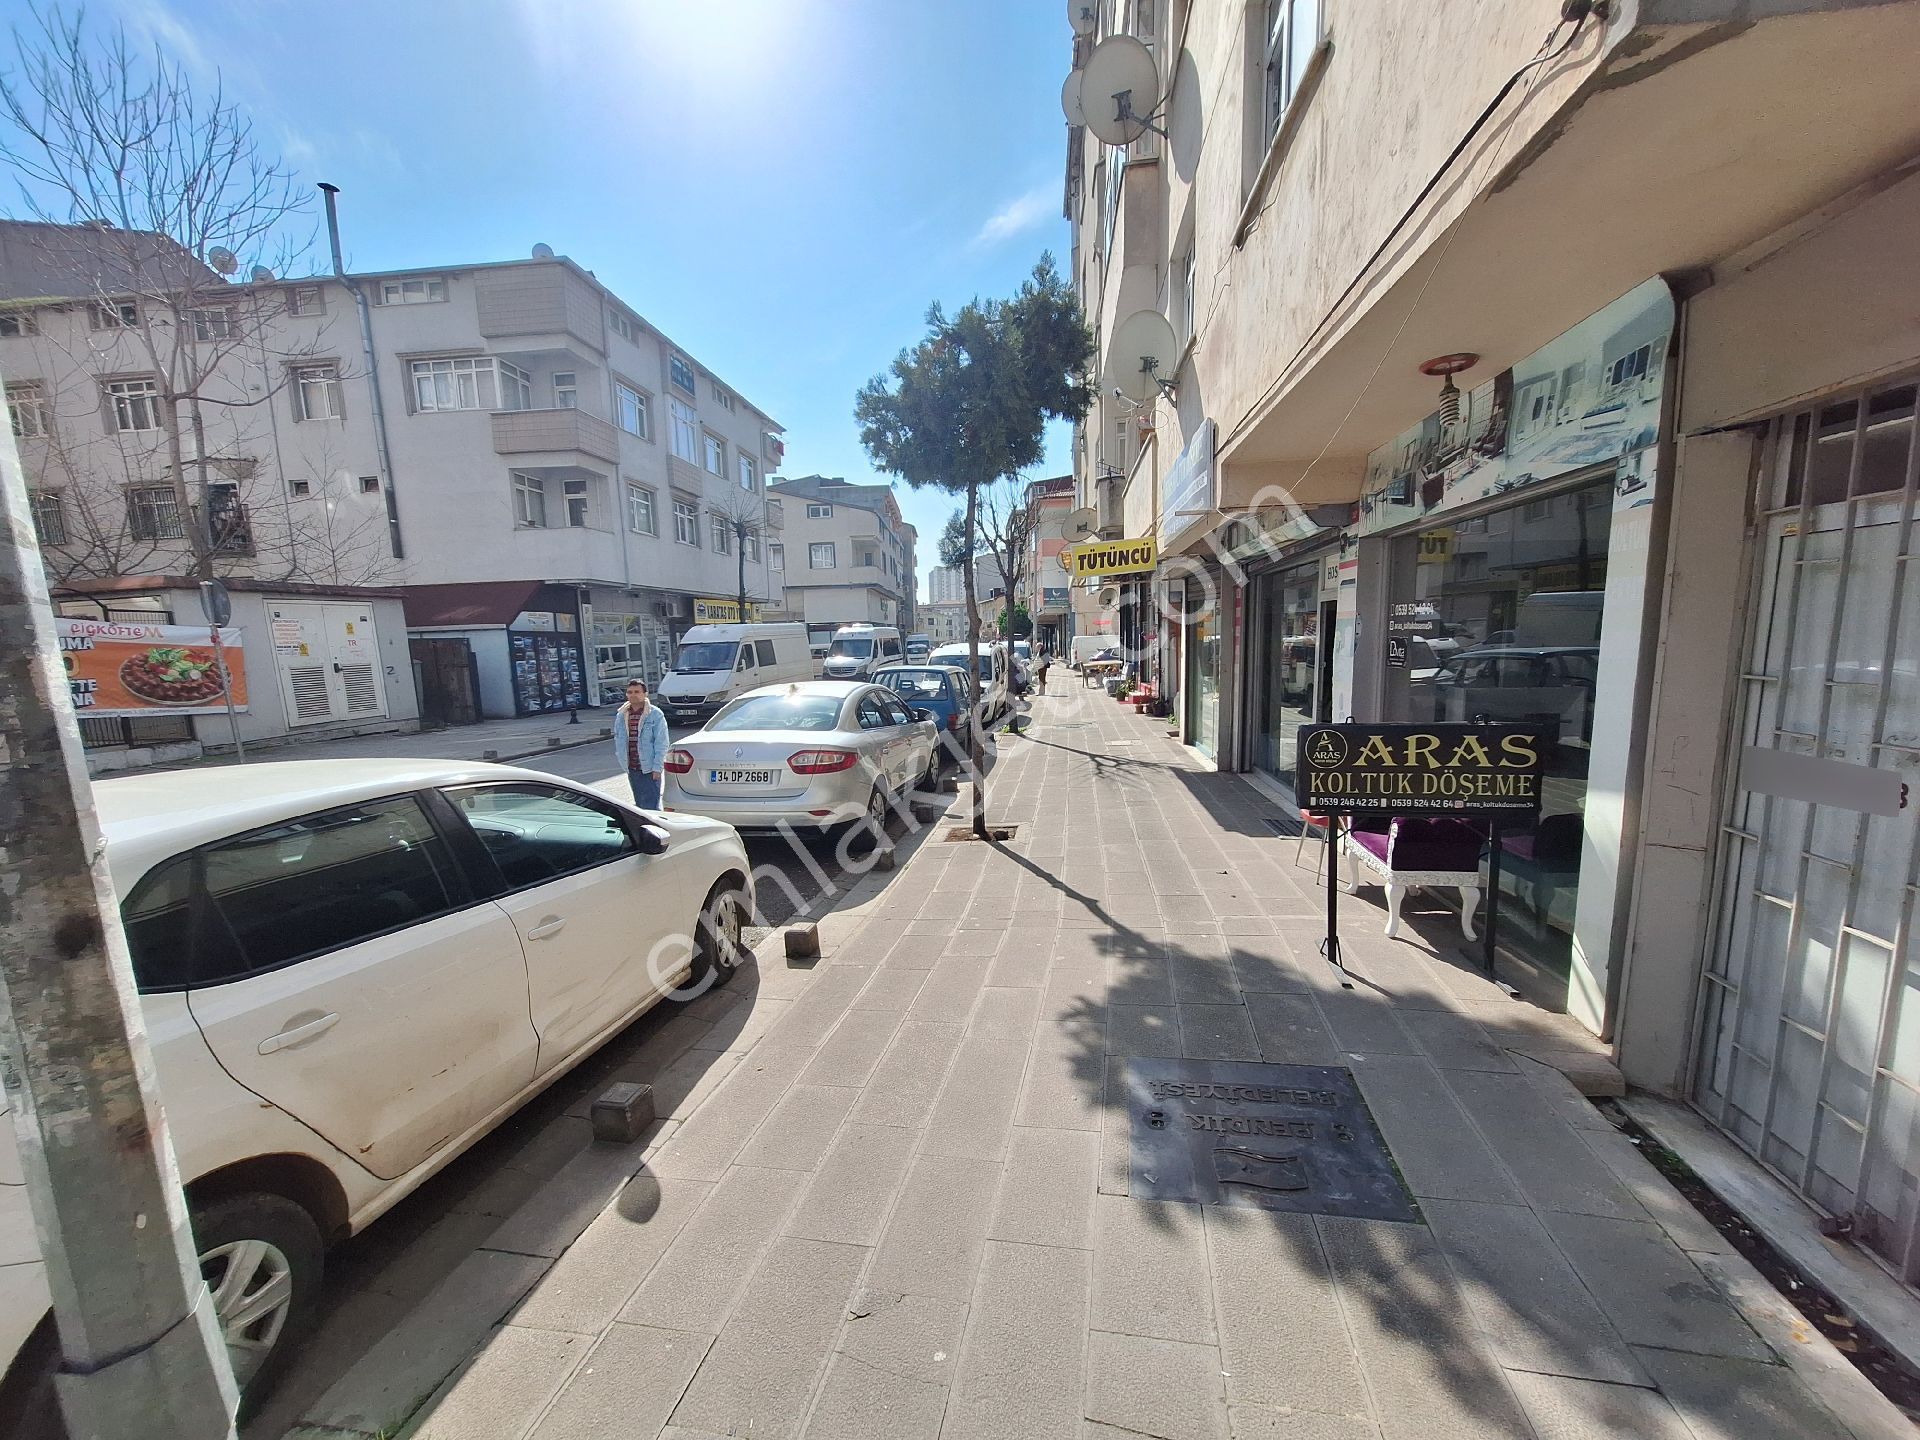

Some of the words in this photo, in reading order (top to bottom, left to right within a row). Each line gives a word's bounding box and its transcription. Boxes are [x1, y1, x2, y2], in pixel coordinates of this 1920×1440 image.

[1078, 542, 1151, 571] TÜTÜNCÜ
[1313, 751, 1341, 759] ARAS
[1352, 734, 1537, 769] ARAS
[718, 771, 729, 782] 34
[731, 771, 743, 782] DP
[745, 771, 769, 782] 2668
[1310, 772, 1413, 796] KOLTUK
[1422, 769, 1535, 801] DÖŞEME
[1319, 797, 1338, 806] 0539
[1340, 798, 1355, 806] 246
[1356, 798, 1366, 807] 42
[1368, 798, 1378, 807] 25
[1391, 799, 1412, 807] 0539
[1414, 799, 1429, 808] 524
[1430, 799, 1441, 808] 42
[1442, 799, 1454, 808] 64
[1152, 1080, 1337, 1108] BELEDİYESİ
[1185, 1114, 1317, 1138] PENDİK
